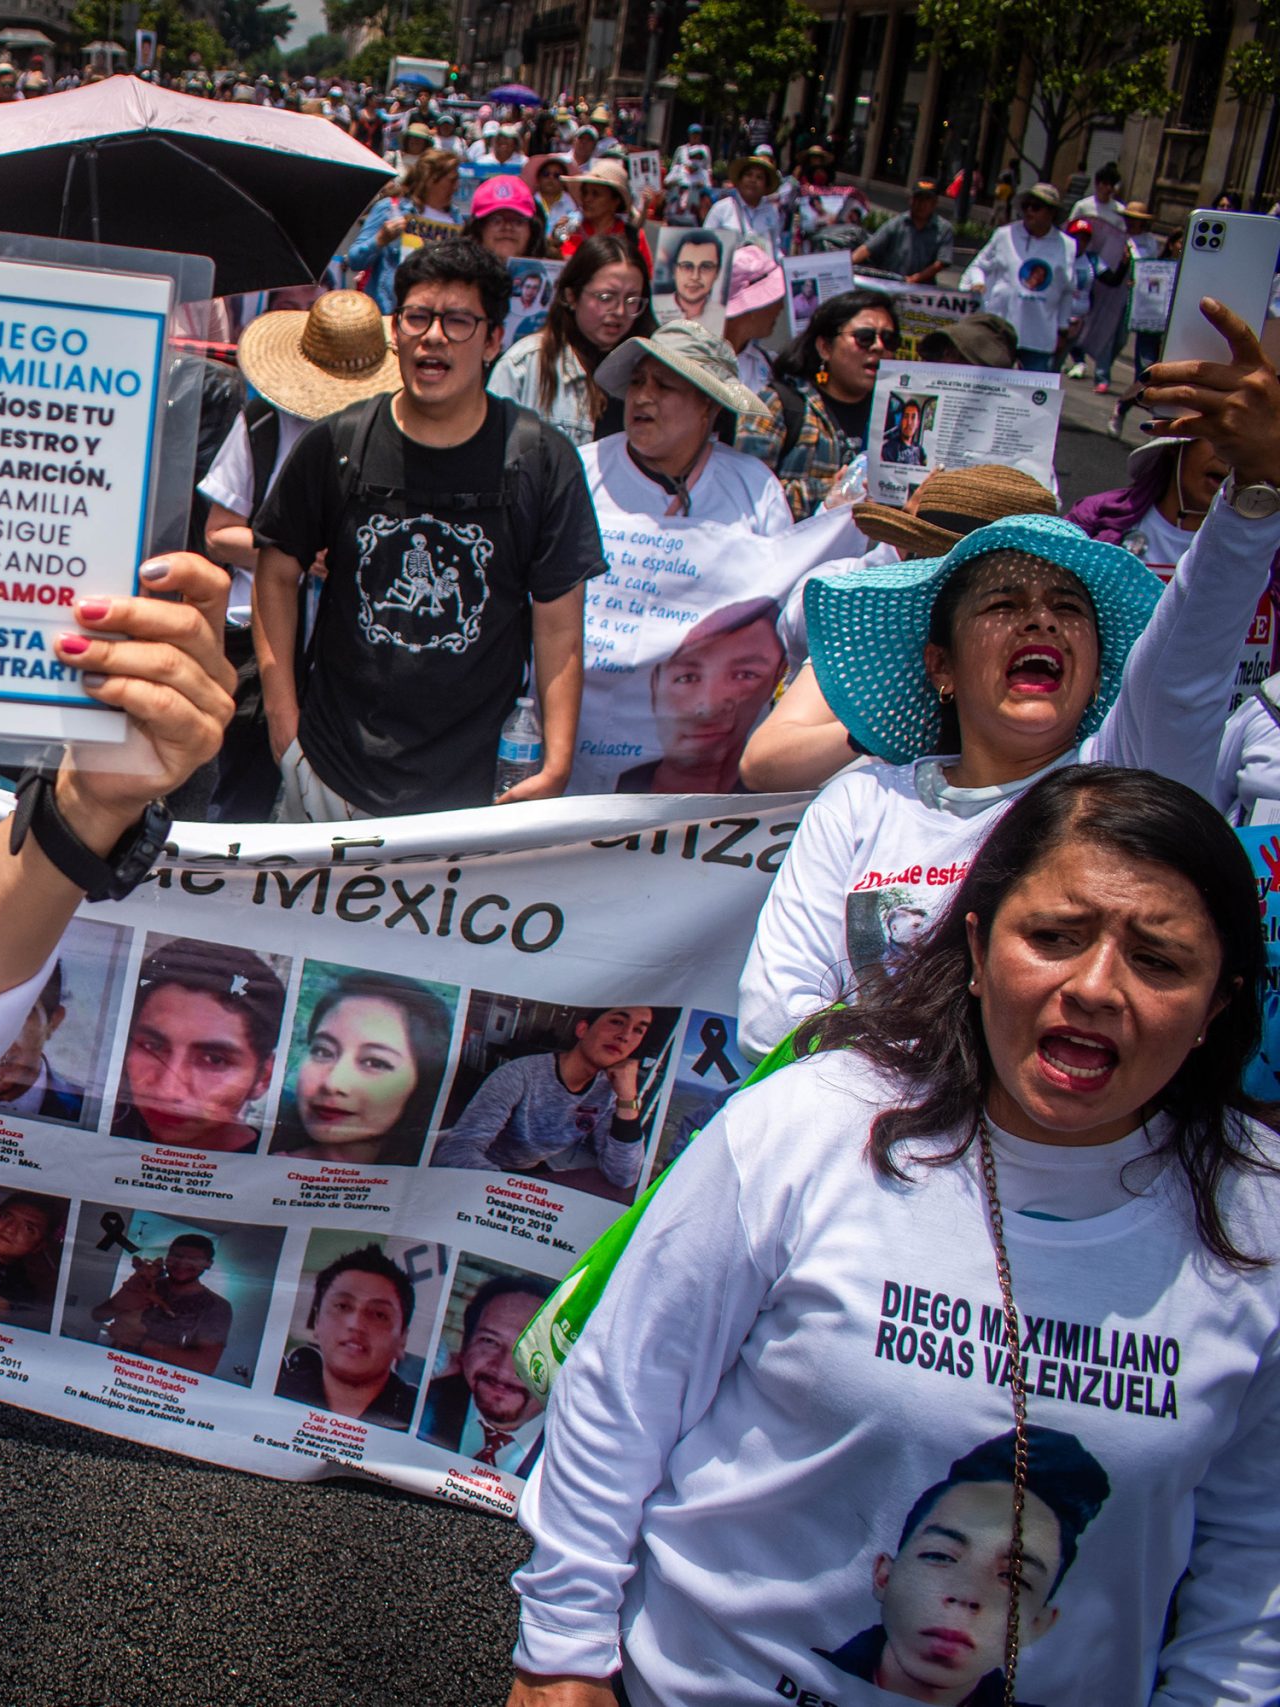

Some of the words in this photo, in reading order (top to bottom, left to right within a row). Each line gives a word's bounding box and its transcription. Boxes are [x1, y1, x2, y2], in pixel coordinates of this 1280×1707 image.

[47, 401, 77, 424] DE
[83, 406, 115, 427] TU
[84, 436, 101, 455] Y
[630, 532, 684, 554] contigo
[621, 550, 637, 566] tu
[641, 556, 702, 580] espalda,
[604, 572, 620, 586] tu
[625, 577, 662, 597] cara,
[605, 597, 624, 610] en
[628, 599, 644, 616] tu
[648, 605, 699, 626] campo
[614, 621, 639, 634] ver
[0, 1146, 25, 1157] 2015
[155, 1147, 207, 1161] Edmundo
[141, 1163, 214, 1179] Desaparecido
[155, 1173, 181, 1184] Abril
[186, 1178, 212, 1187] 2017
[320, 1166, 361, 1176] Patricia
[114, 1177, 129, 1186] En
[131, 1179, 168, 1191] Estado
[170, 1185, 184, 1194] de
[186, 1187, 234, 1200] Guerrero
[300, 1182, 372, 1193] Desaparecida
[313, 1192, 339, 1200] Abril
[506, 1177, 549, 1196] Cristian
[272, 1197, 287, 1206] En
[289, 1199, 326, 1208] Estado
[328, 1201, 342, 1209] de
[343, 1202, 391, 1212] Guerrero
[485, 1184, 523, 1201] Gómez
[525, 1193, 565, 1213] Chávez
[486, 1195, 559, 1222] Desaparecido
[456, 1211, 471, 1222] En
[475, 1215, 508, 1232] Toluca
[510, 1225, 534, 1240] Edo.
[536, 1234, 551, 1245] de
[552, 1238, 577, 1254] Méx.
[496, 1209, 525, 1225] Mayo
[527, 1218, 553, 1233] 2019
[880, 1280, 972, 1337] DIEGO
[979, 1304, 1181, 1377] MAXIMILIANO
[0, 1356, 22, 1369] 2011
[107, 1351, 154, 1372] Sebastian
[156, 1366, 168, 1376] de
[170, 1370, 199, 1386] Jesus
[875, 1319, 975, 1379] ROSAS
[984, 1345, 1179, 1420] VALENZUELA
[6, 1370, 29, 1383] 2019
[114, 1365, 144, 1381] Rivera
[146, 1375, 186, 1394] Delgado
[109, 1388, 160, 1408] Noviembre
[162, 1403, 185, 1414] 2020
[115, 1377, 179, 1404] Desaparecido
[64, 1386, 77, 1396] En
[79, 1390, 125, 1410] Municipio
[127, 1404, 145, 1415] San
[146, 1407, 184, 1424] Antonio
[308, 1411, 328, 1424] Yair
[329, 1417, 368, 1435] Octavio
[253, 1434, 265, 1444] En
[266, 1438, 290, 1451] Santa
[292, 1443, 318, 1458] Teresa
[296, 1429, 365, 1452] Desaparecido
[330, 1428, 366, 1443] Arenas
[306, 1440, 337, 1453] Marzo
[338, 1449, 363, 1460] 2020
[448, 1468, 492, 1492] Quesada
[494, 1486, 516, 1502] Ruiz
[470, 1465, 502, 1483] Jaime
[445, 1478, 513, 1513] Desaparecido
